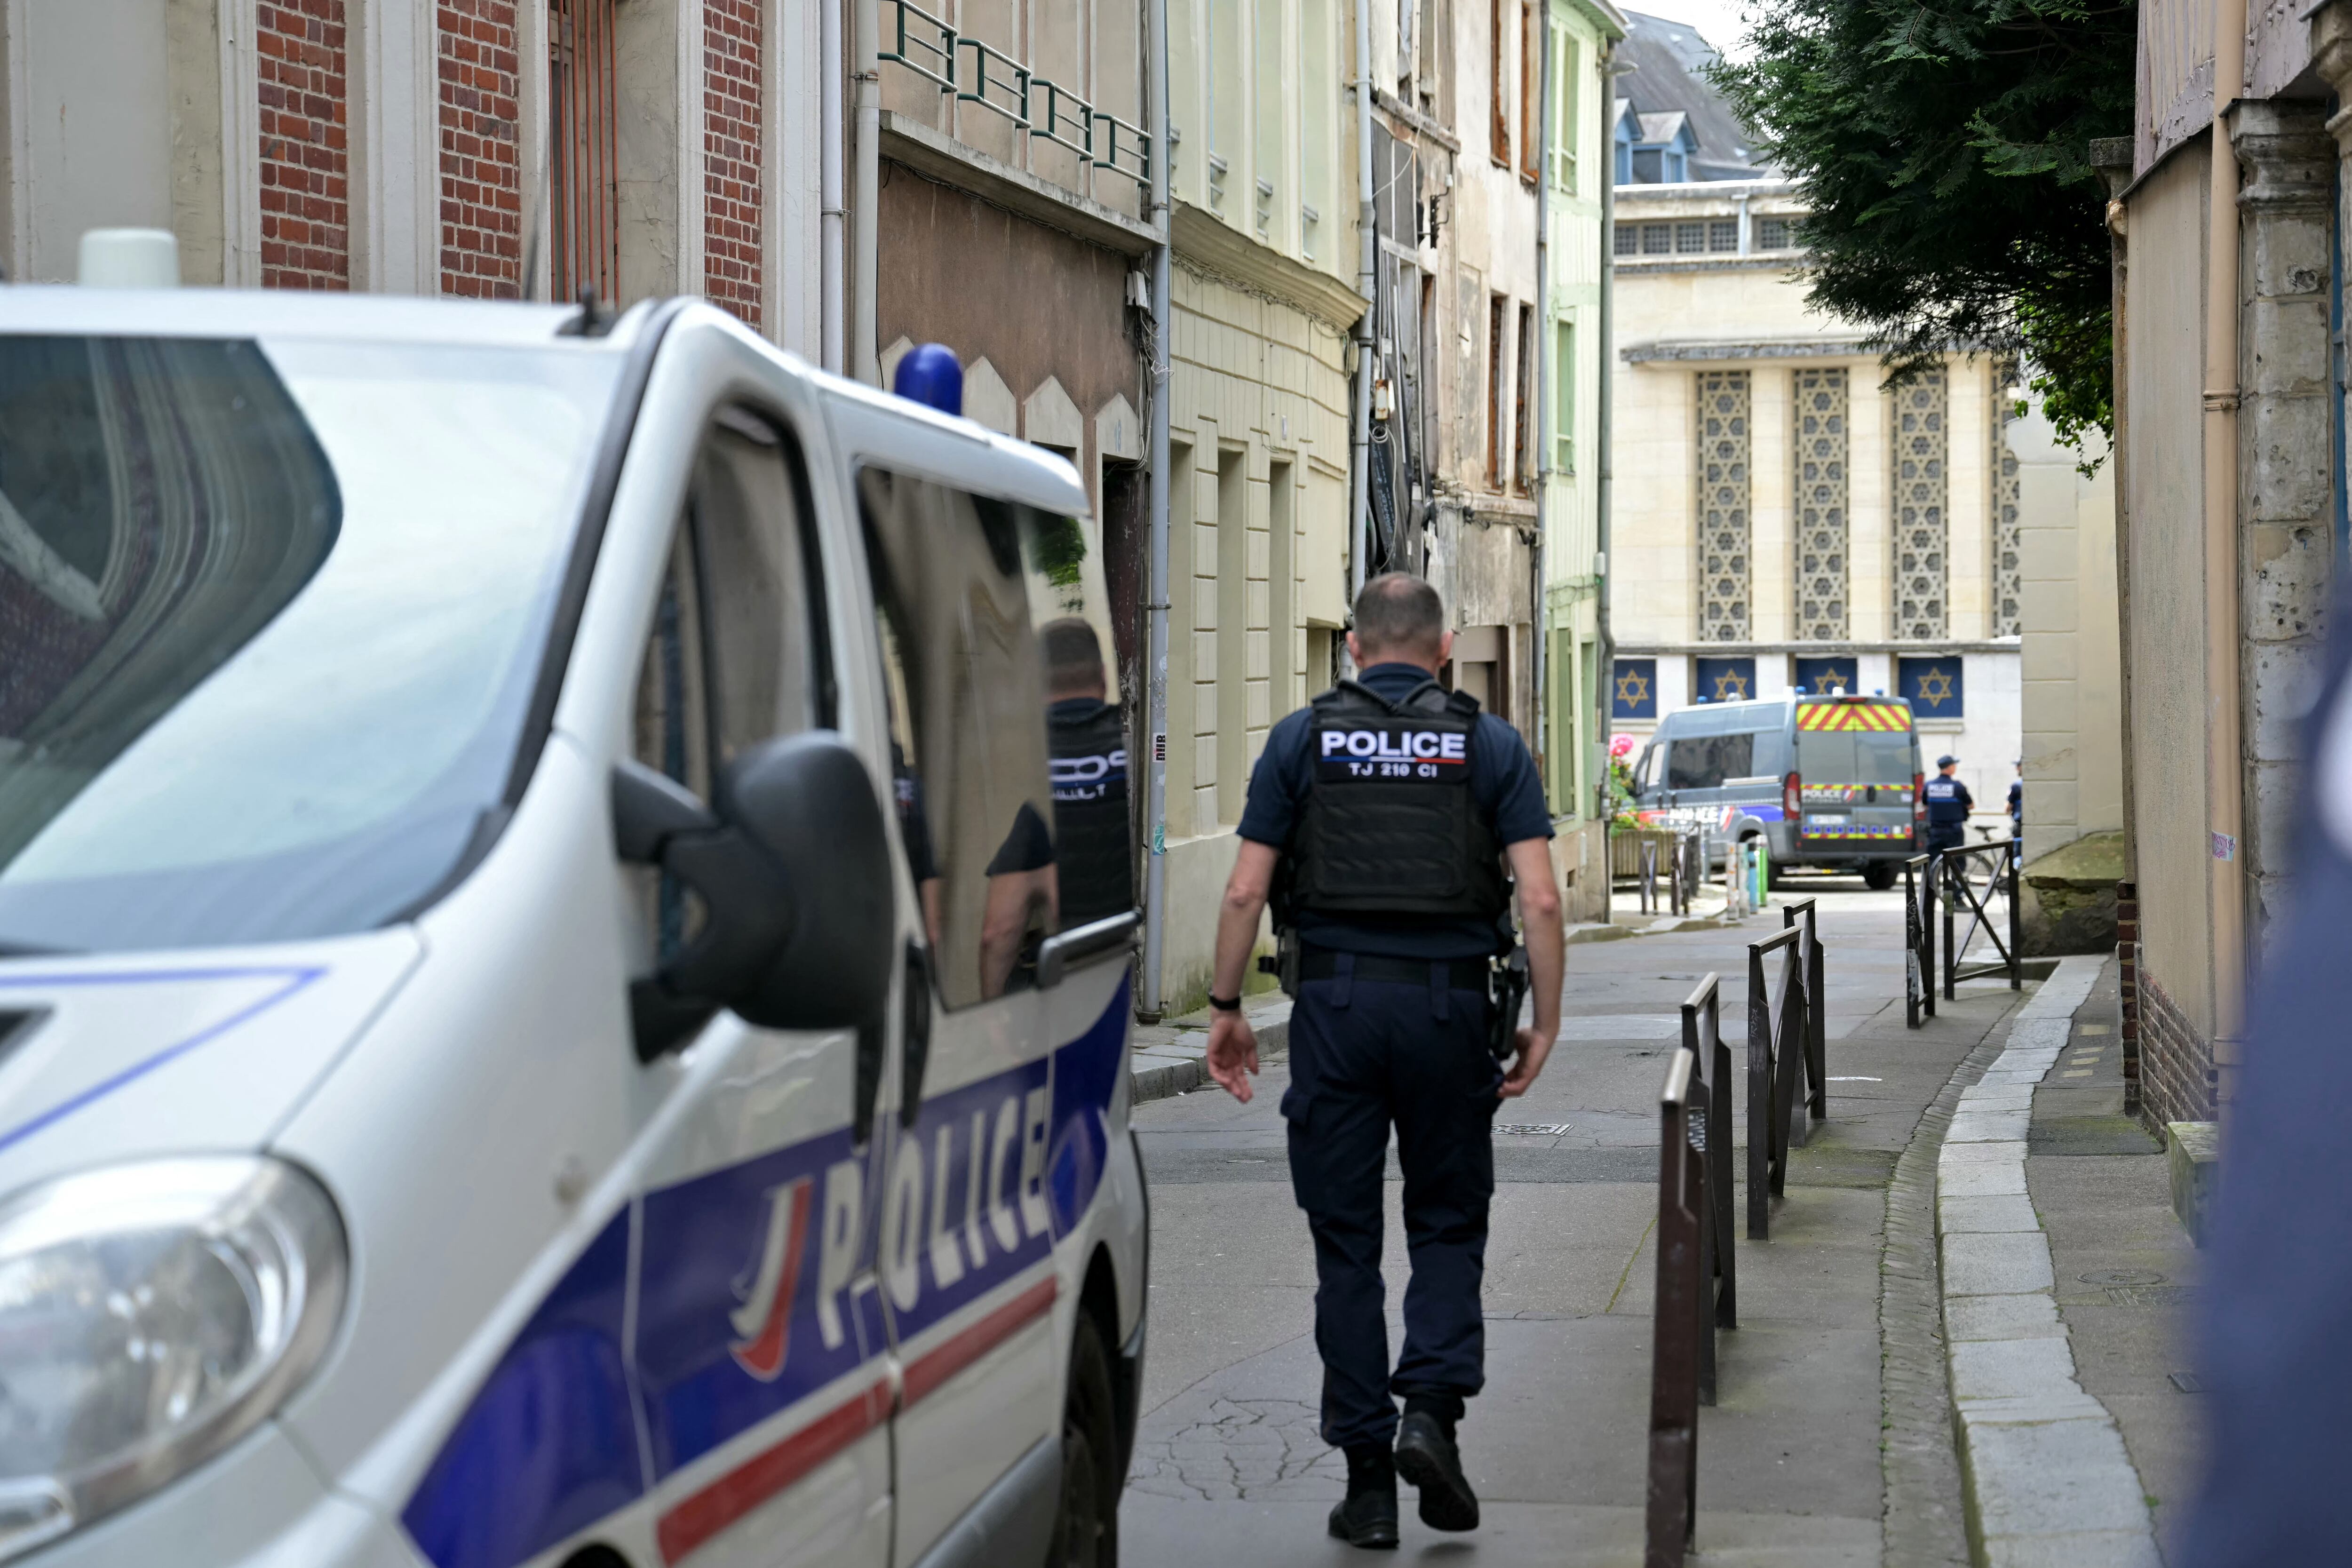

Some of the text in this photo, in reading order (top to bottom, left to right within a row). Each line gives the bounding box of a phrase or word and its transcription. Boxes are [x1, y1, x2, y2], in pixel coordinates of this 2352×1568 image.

[1321, 730, 1466, 759] POLICE
[1348, 763, 1374, 776] TJ
[1381, 763, 1410, 777] 210
[1802, 789, 1841, 798] POLICE
[817, 1086, 1048, 1349] POLICE
